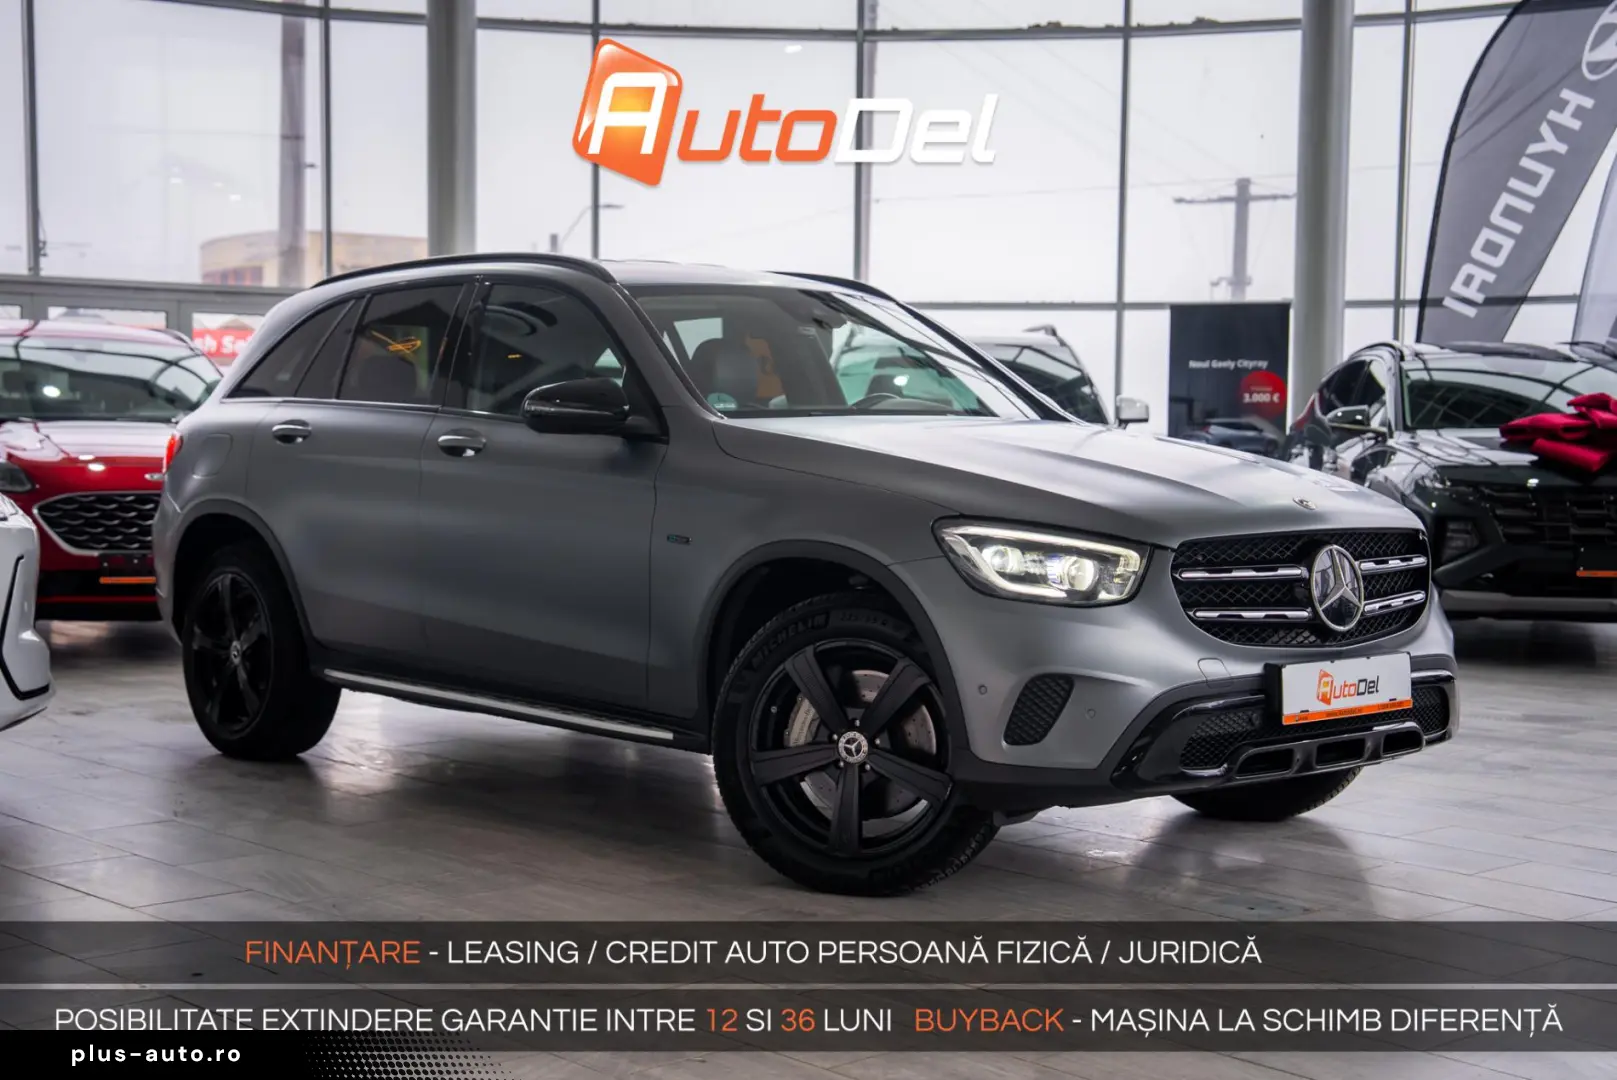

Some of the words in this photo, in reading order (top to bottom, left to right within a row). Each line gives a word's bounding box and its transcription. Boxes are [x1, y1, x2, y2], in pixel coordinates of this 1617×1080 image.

[1211, 359, 1235, 371] Geely
[1237, 358, 1269, 370] Cityray
[1318, 672, 1380, 700] AutoDel
